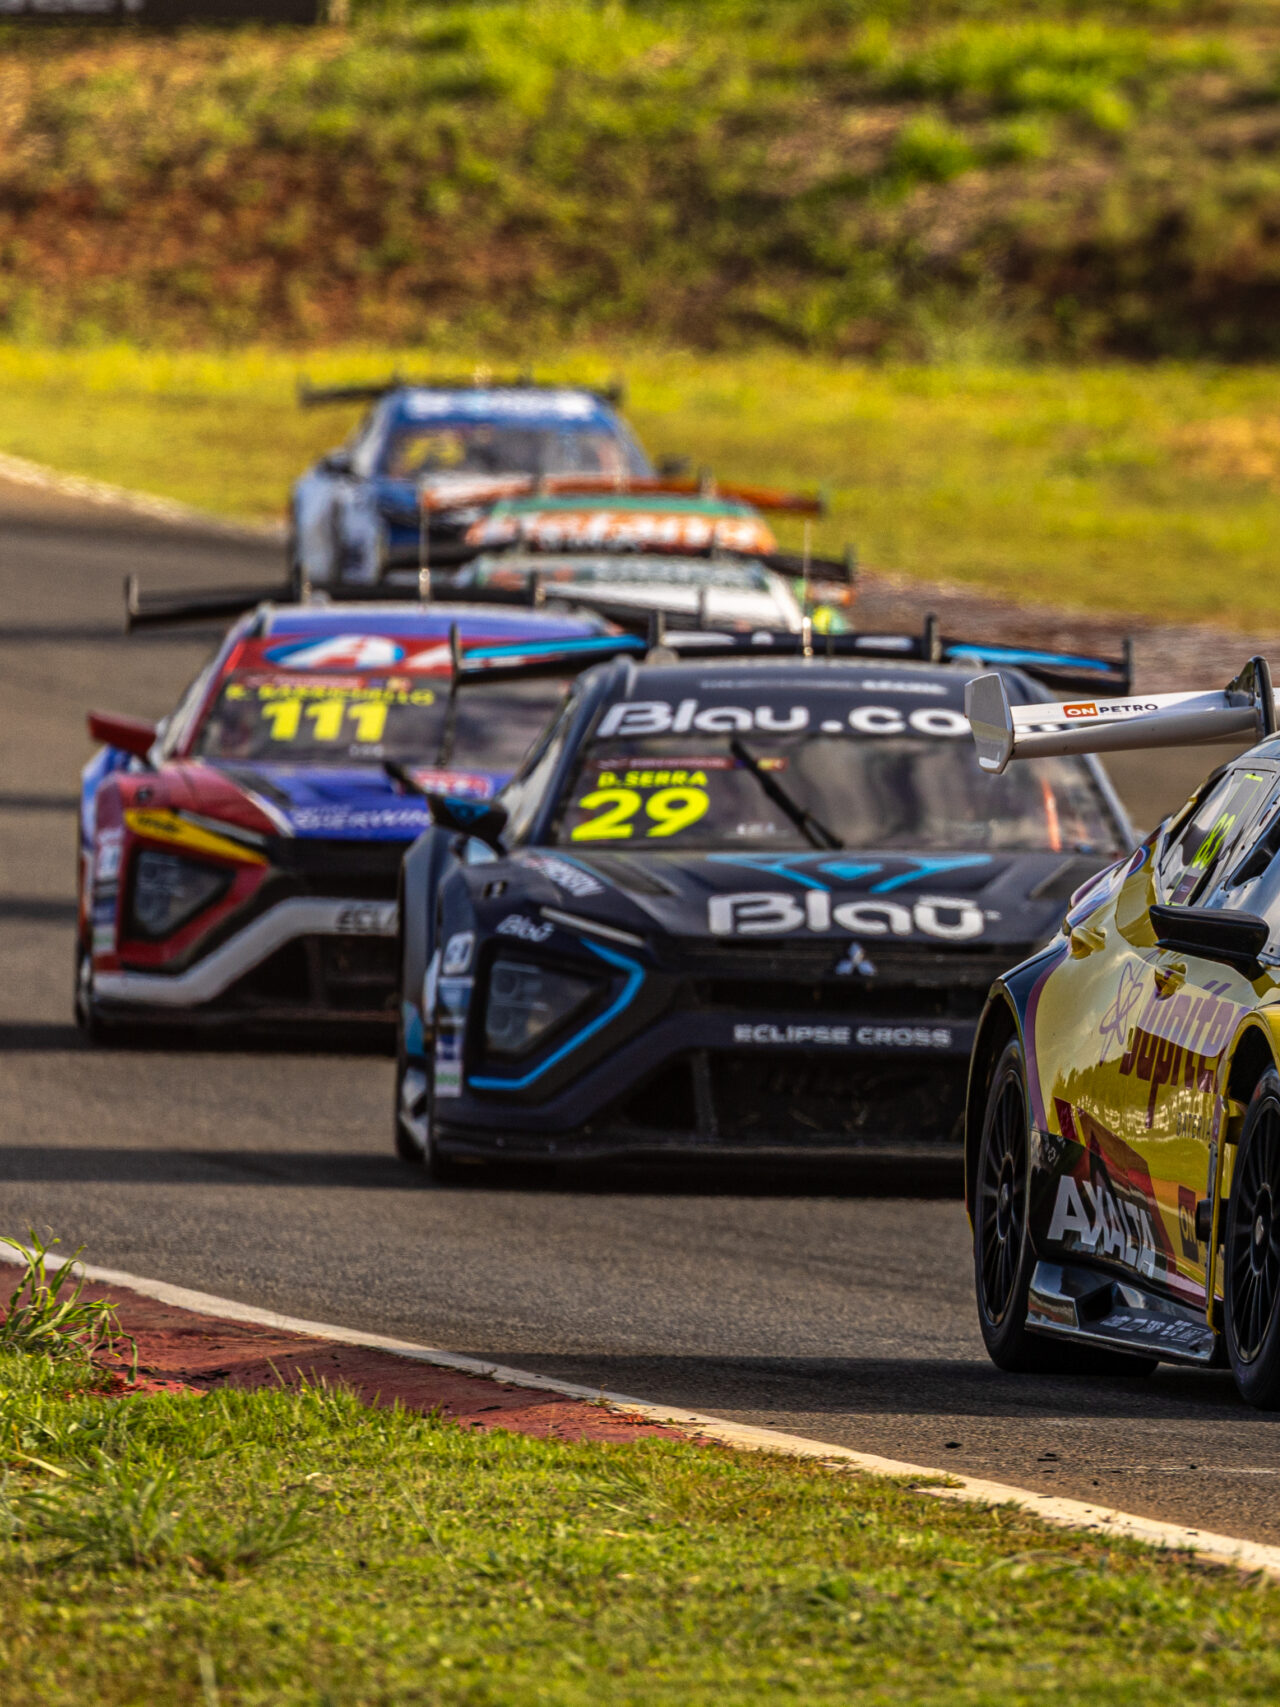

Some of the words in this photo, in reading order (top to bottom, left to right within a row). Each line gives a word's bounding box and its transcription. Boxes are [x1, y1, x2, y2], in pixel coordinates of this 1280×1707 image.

[261, 698, 388, 742] 111
[571, 786, 710, 841] 29
[734, 1024, 850, 1044] ECLIPSE
[857, 1028, 951, 1048] CROSS
